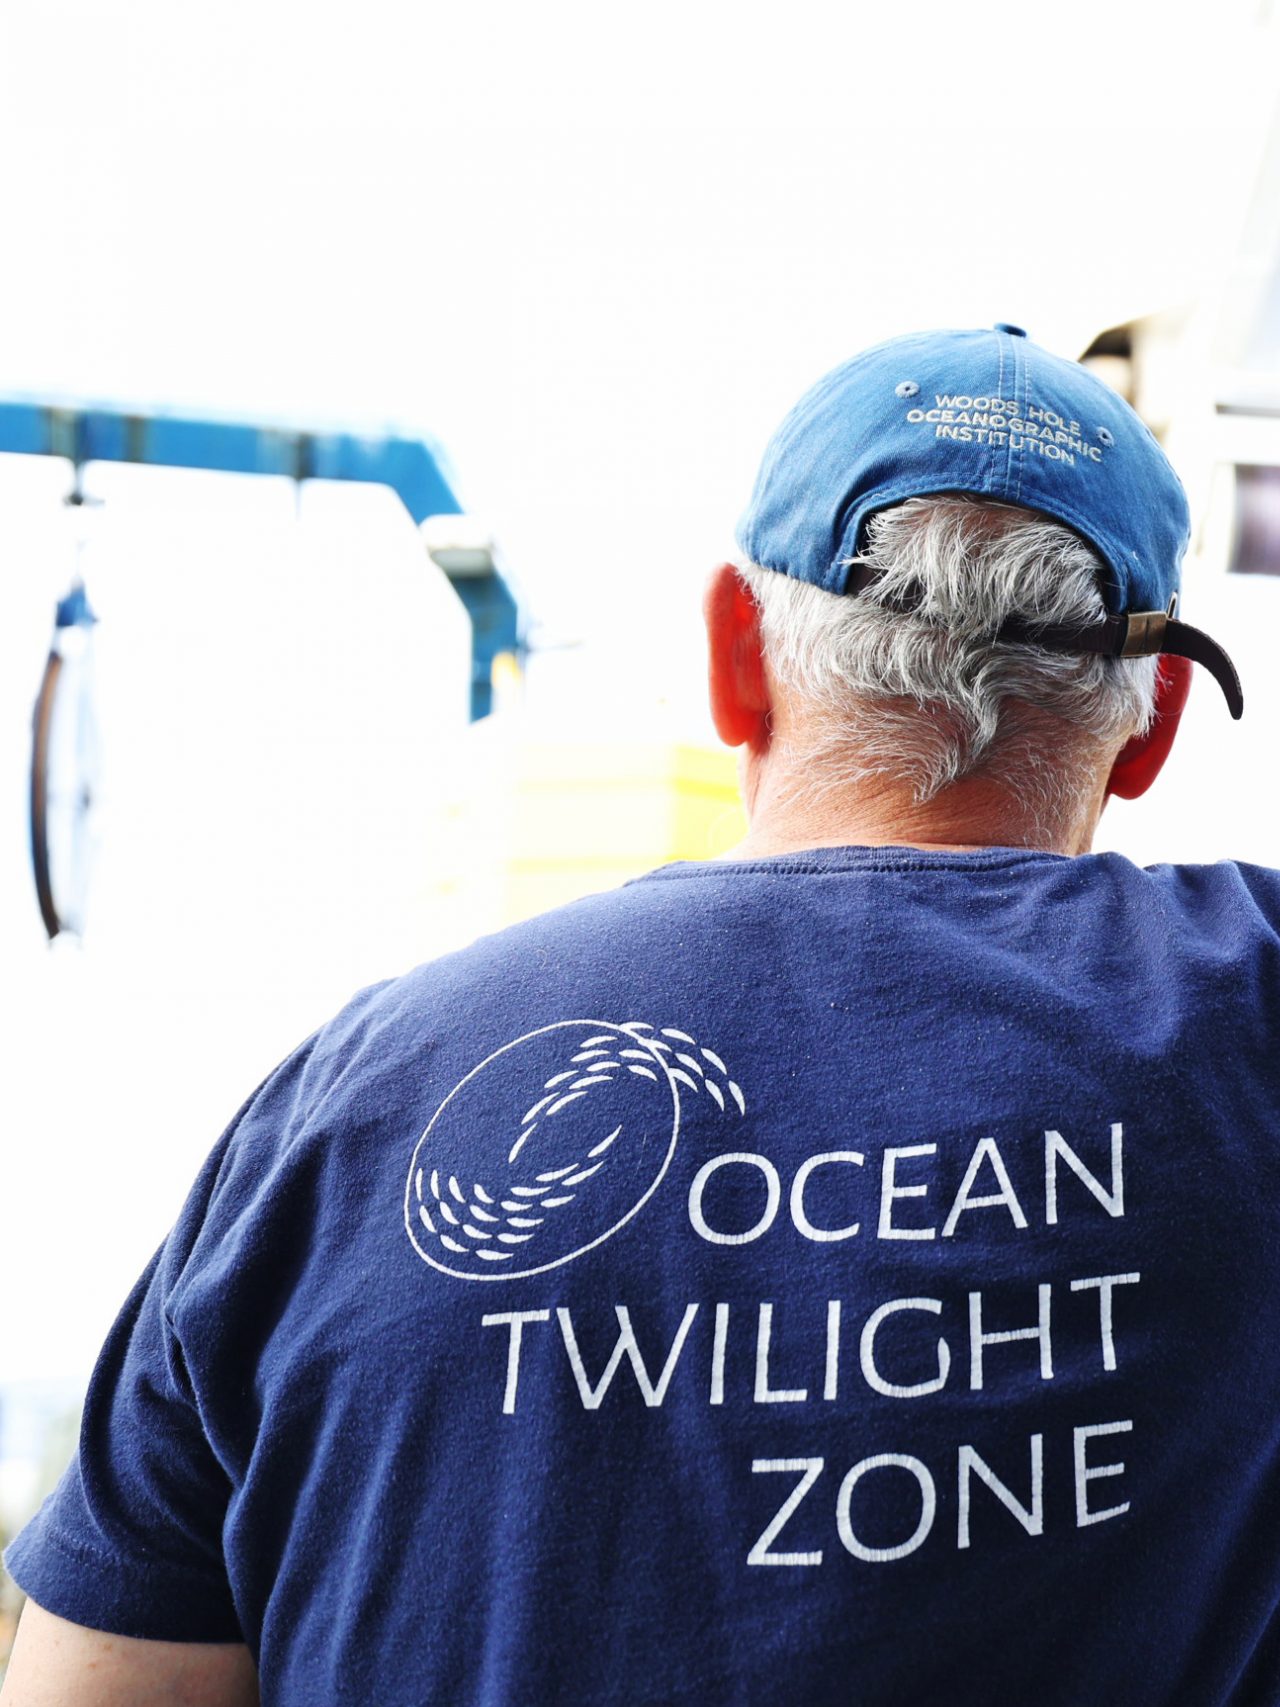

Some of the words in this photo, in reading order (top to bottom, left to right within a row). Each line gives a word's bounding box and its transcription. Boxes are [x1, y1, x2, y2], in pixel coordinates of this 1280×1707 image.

[907, 409, 1102, 462] OCEANOGRAPHIC
[935, 394, 1019, 415] WOODS
[1028, 406, 1081, 435] HOLE
[935, 424, 1075, 463] INSTITUTION
[688, 1123, 1125, 1244] OCEAN
[482, 1273, 1140, 1414] TWILIGHT
[746, 1421, 1133, 1565] ZONE
